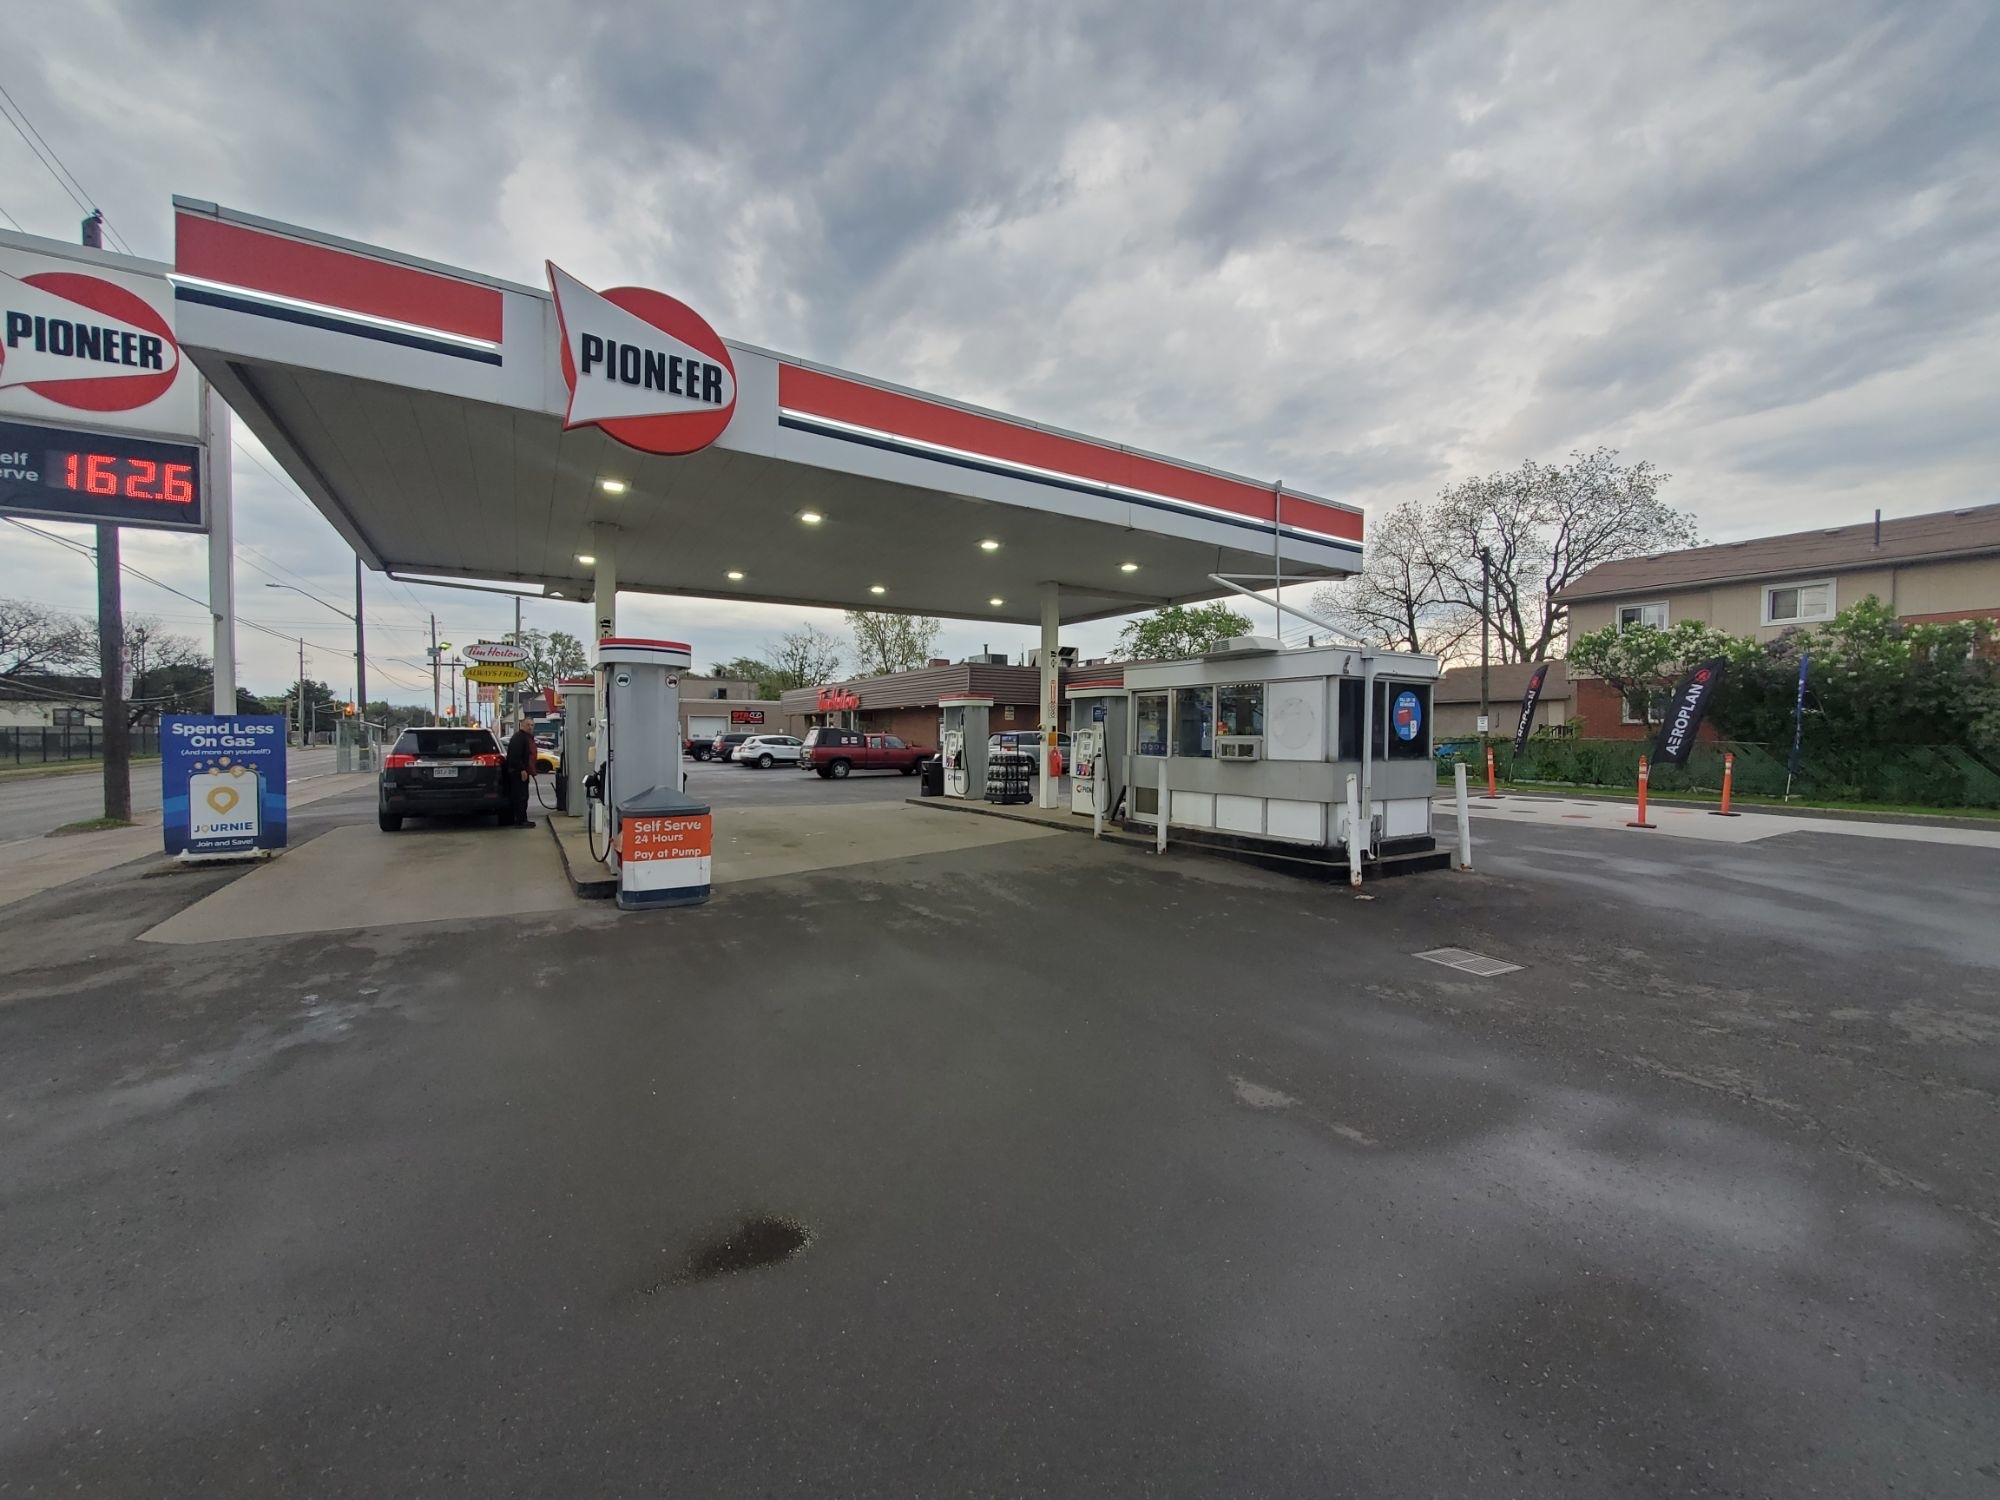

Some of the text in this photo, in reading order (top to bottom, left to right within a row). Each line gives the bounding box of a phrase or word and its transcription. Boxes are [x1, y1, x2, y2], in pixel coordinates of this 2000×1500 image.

[7, 311, 163, 371] PIONEER
[581, 332, 723, 405] PIONEER
[0, 452, 28, 466] elf
[0, 467, 39, 482] rve
[467, 645, 524, 658] Tim Hortons
[498, 670, 524, 678] FRESH
[1665, 683, 1705, 756] AEROPLAN
[172, 723, 274, 736] Spend Less
[190, 736, 256, 747] On Gas
[194, 822, 254, 833] JOURNIE
[634, 820, 702, 833] Self Serve
[231, 838, 254, 846] Save!
[634, 833, 684, 844] 24 Hours
[634, 848, 702, 860] Pay at Pump
